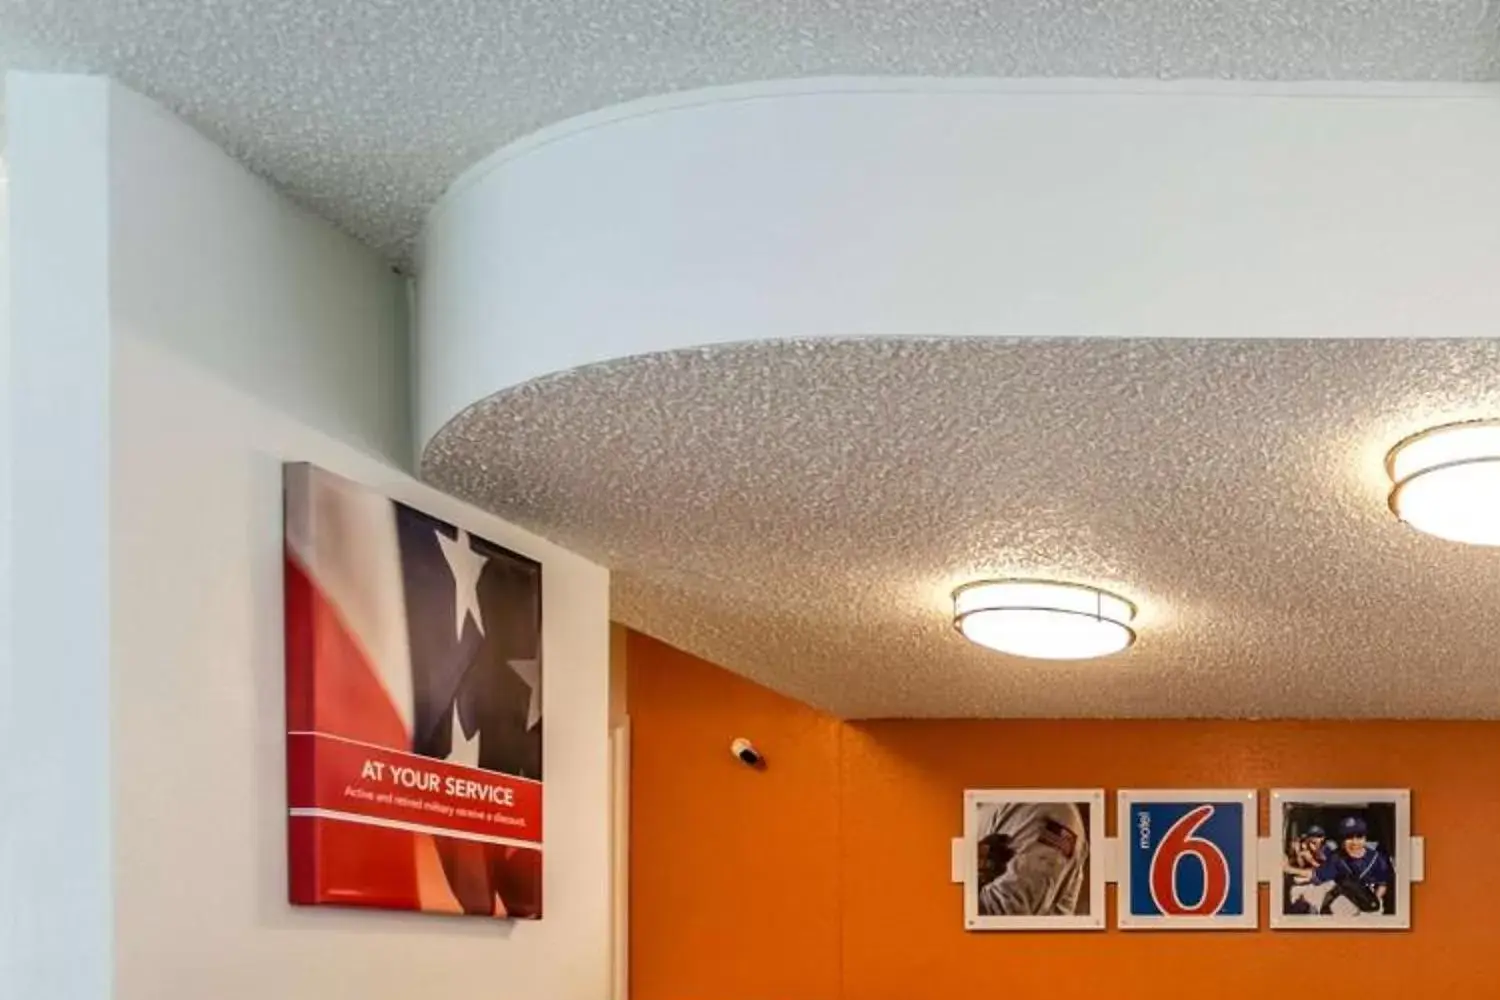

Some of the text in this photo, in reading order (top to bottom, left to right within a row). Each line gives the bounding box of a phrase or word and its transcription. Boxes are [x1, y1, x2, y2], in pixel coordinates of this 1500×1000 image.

[362, 759, 514, 807] AT YOUR SERVICE
[1137, 811, 1151, 849] motel
[1149, 804, 1230, 918] 6
